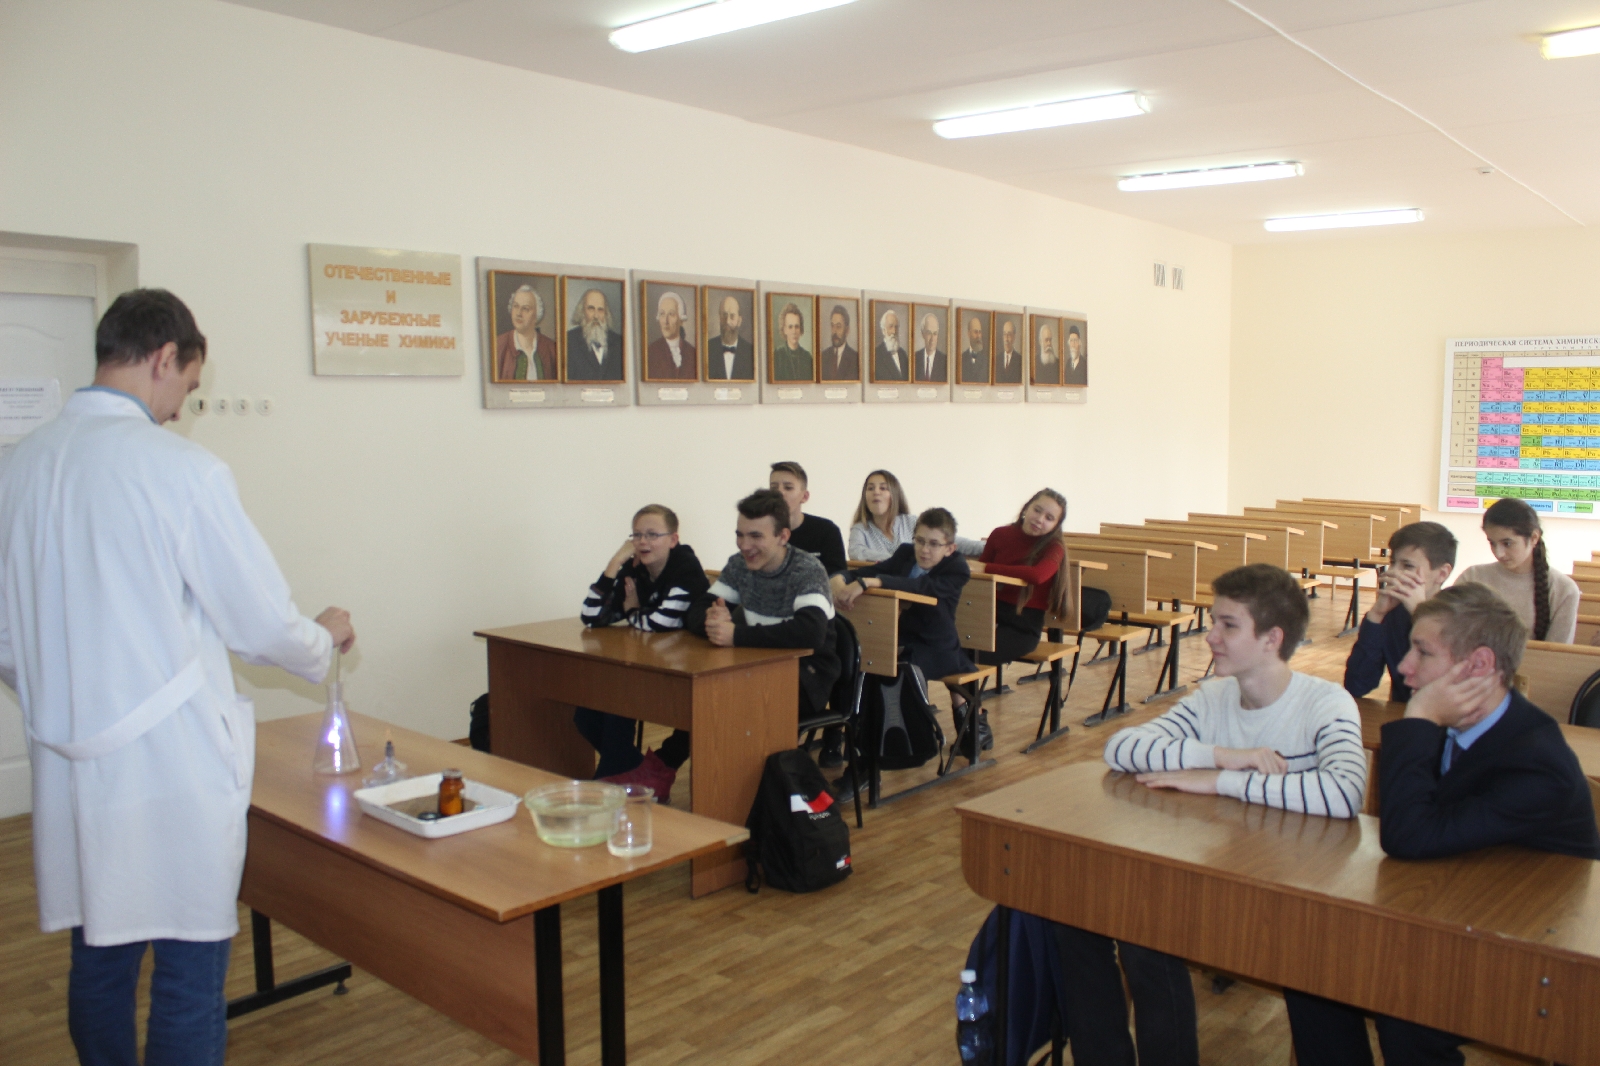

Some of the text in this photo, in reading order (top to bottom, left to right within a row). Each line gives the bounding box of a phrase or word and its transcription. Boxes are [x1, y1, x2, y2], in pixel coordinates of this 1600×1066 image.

[323, 263, 452, 286] ОТЕЧЕСТВЕННЫЕ
[385, 290, 397, 304] И
[340, 309, 441, 327] ЗАРУБЕЖНЫЕ
[325, 331, 456, 349] УЧЕНЫЕ ХИМИКИ
